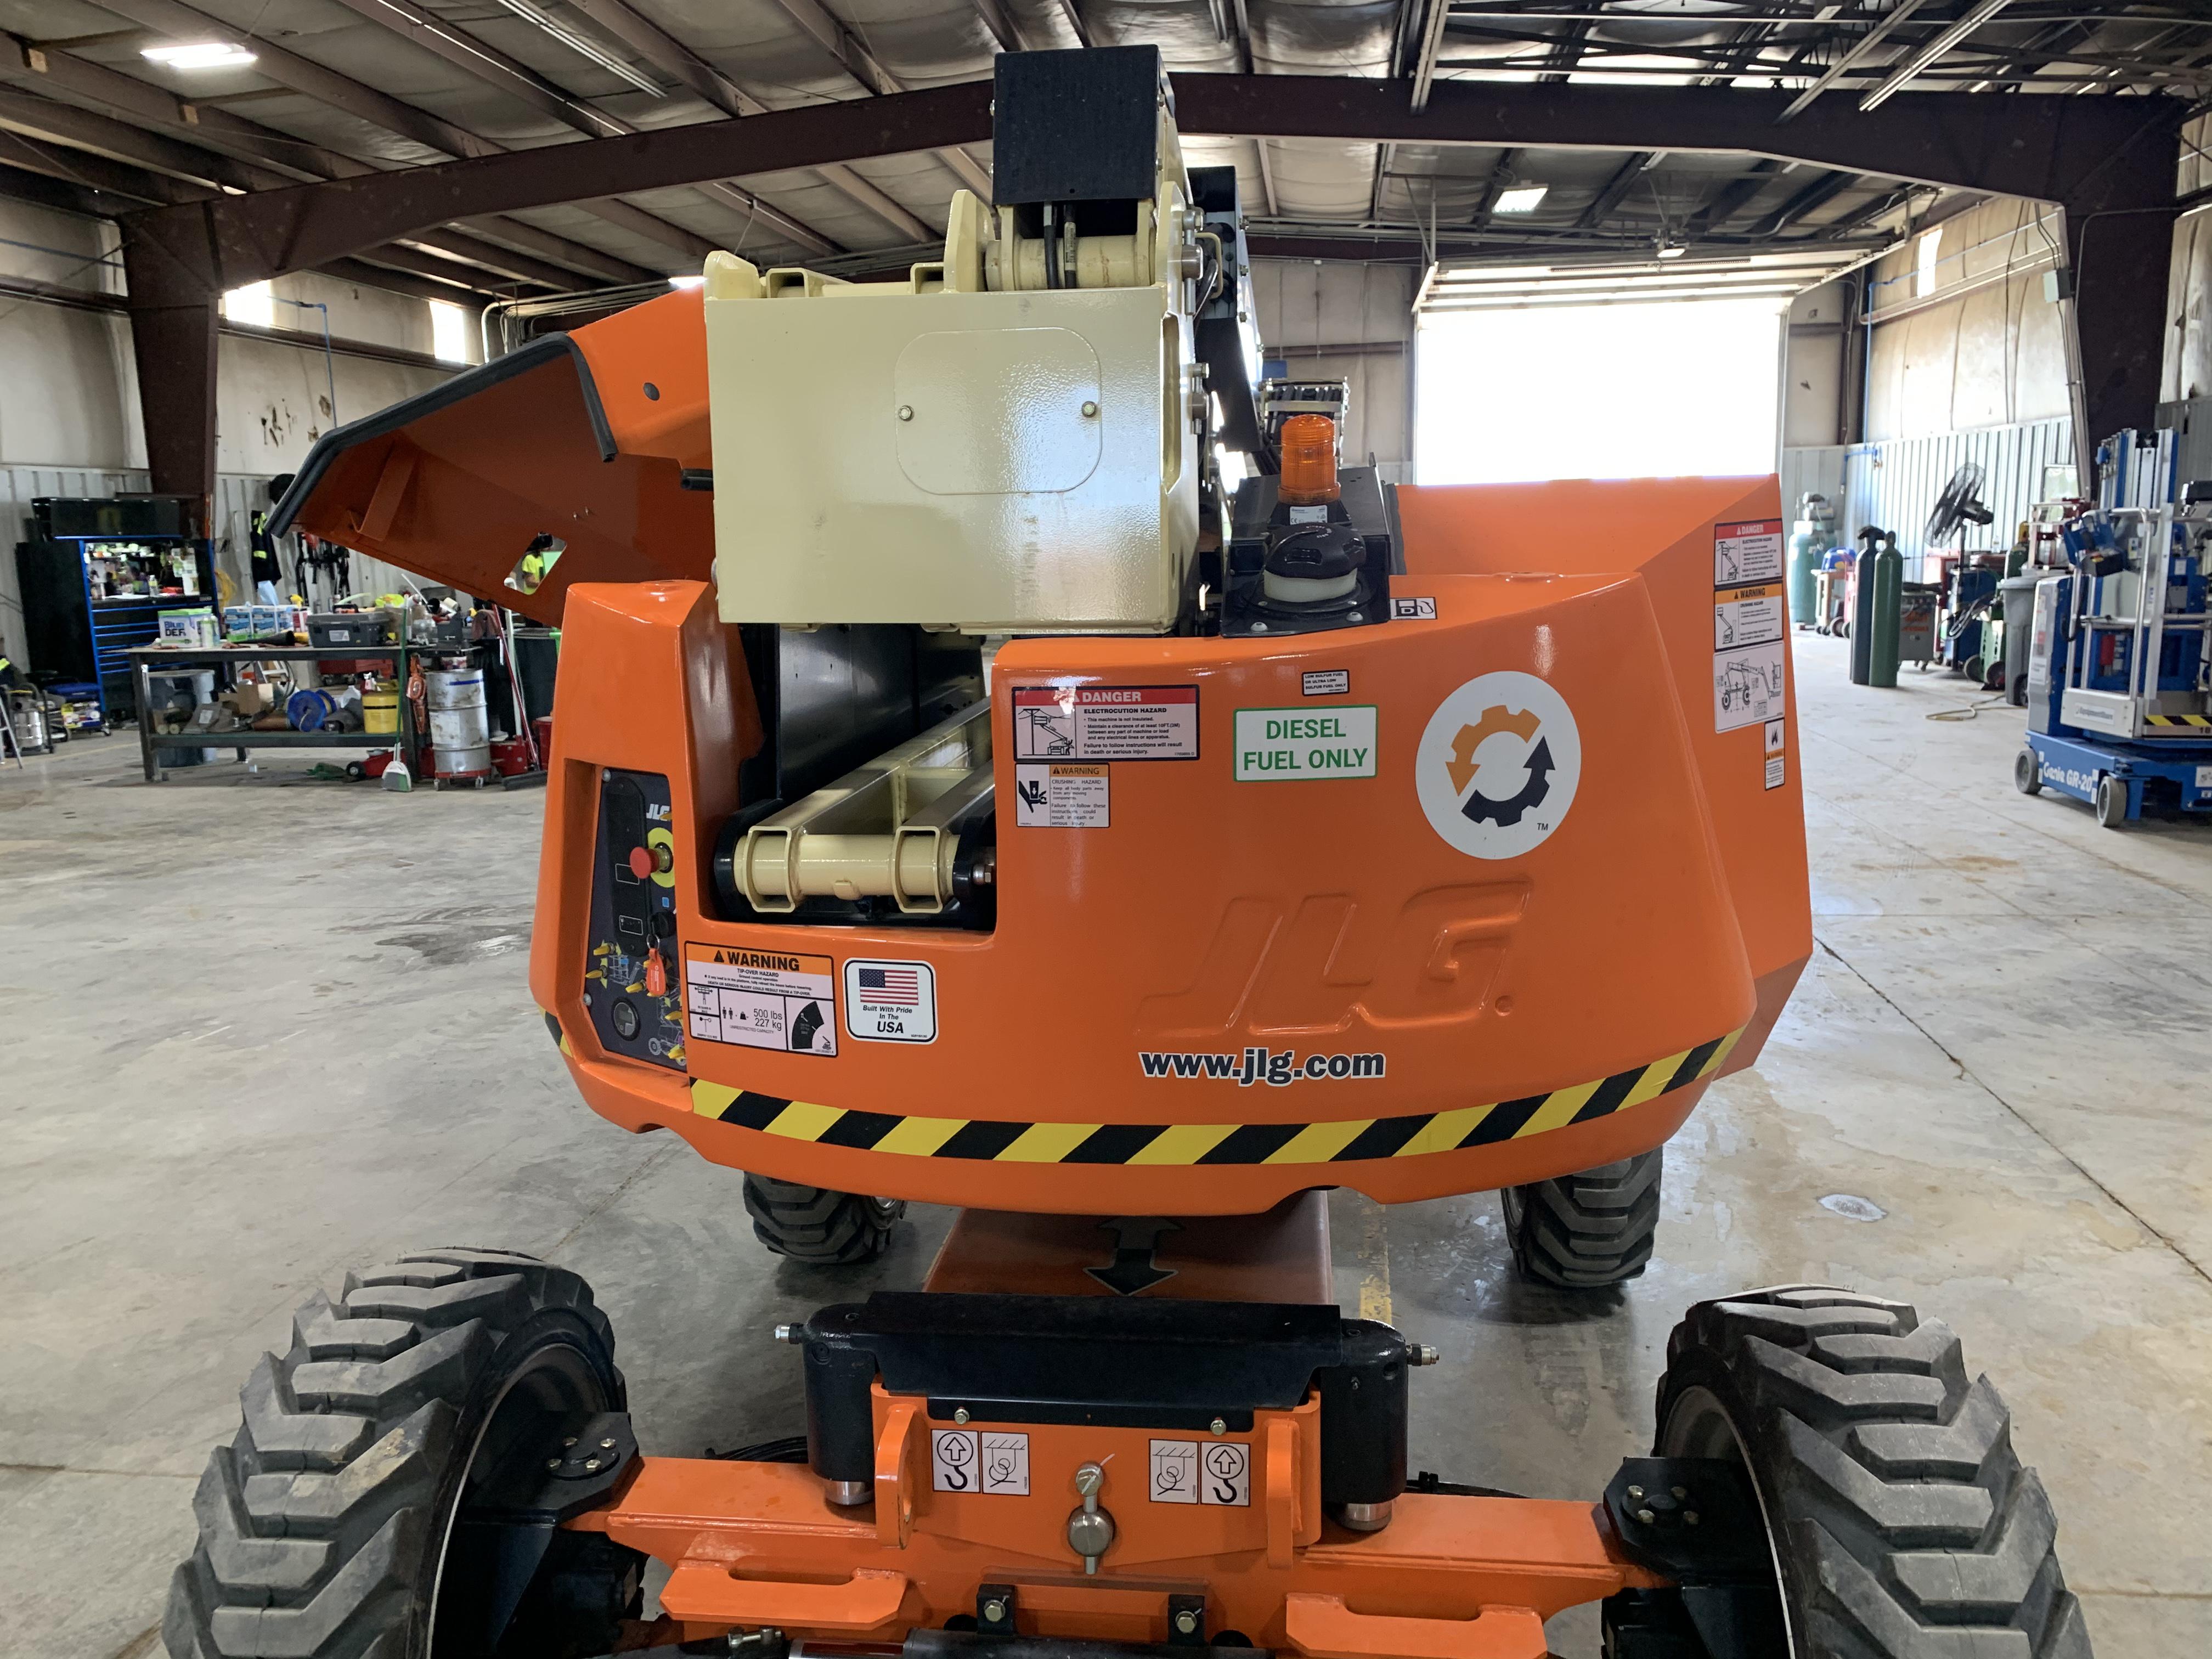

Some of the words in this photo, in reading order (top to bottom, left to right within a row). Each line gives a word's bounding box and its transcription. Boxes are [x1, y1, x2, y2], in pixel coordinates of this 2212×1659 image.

[1742, 524, 1764, 535] DANGER
[1740, 588, 1765, 599] WARNING
[1082, 691, 1142, 703] DANGER
[1266, 718, 1346, 740] DIESEL
[1244, 751, 1301, 770] FUEL
[1308, 748, 1368, 768] ONLY
[2043, 761, 2065, 783] Genie
[2066, 769, 2093, 793] GR-20
[727, 950, 800, 972] WARNING
[1132, 877, 1531, 1036] JLG
[753, 1008, 769, 1019] 500
[770, 1011, 782, 1020] lbs
[755, 1018, 769, 1028] 227
[772, 1020, 782, 1031] kg
[877, 1020, 904, 1034] USA
[1139, 1047, 1386, 1086] www.jlg.com
